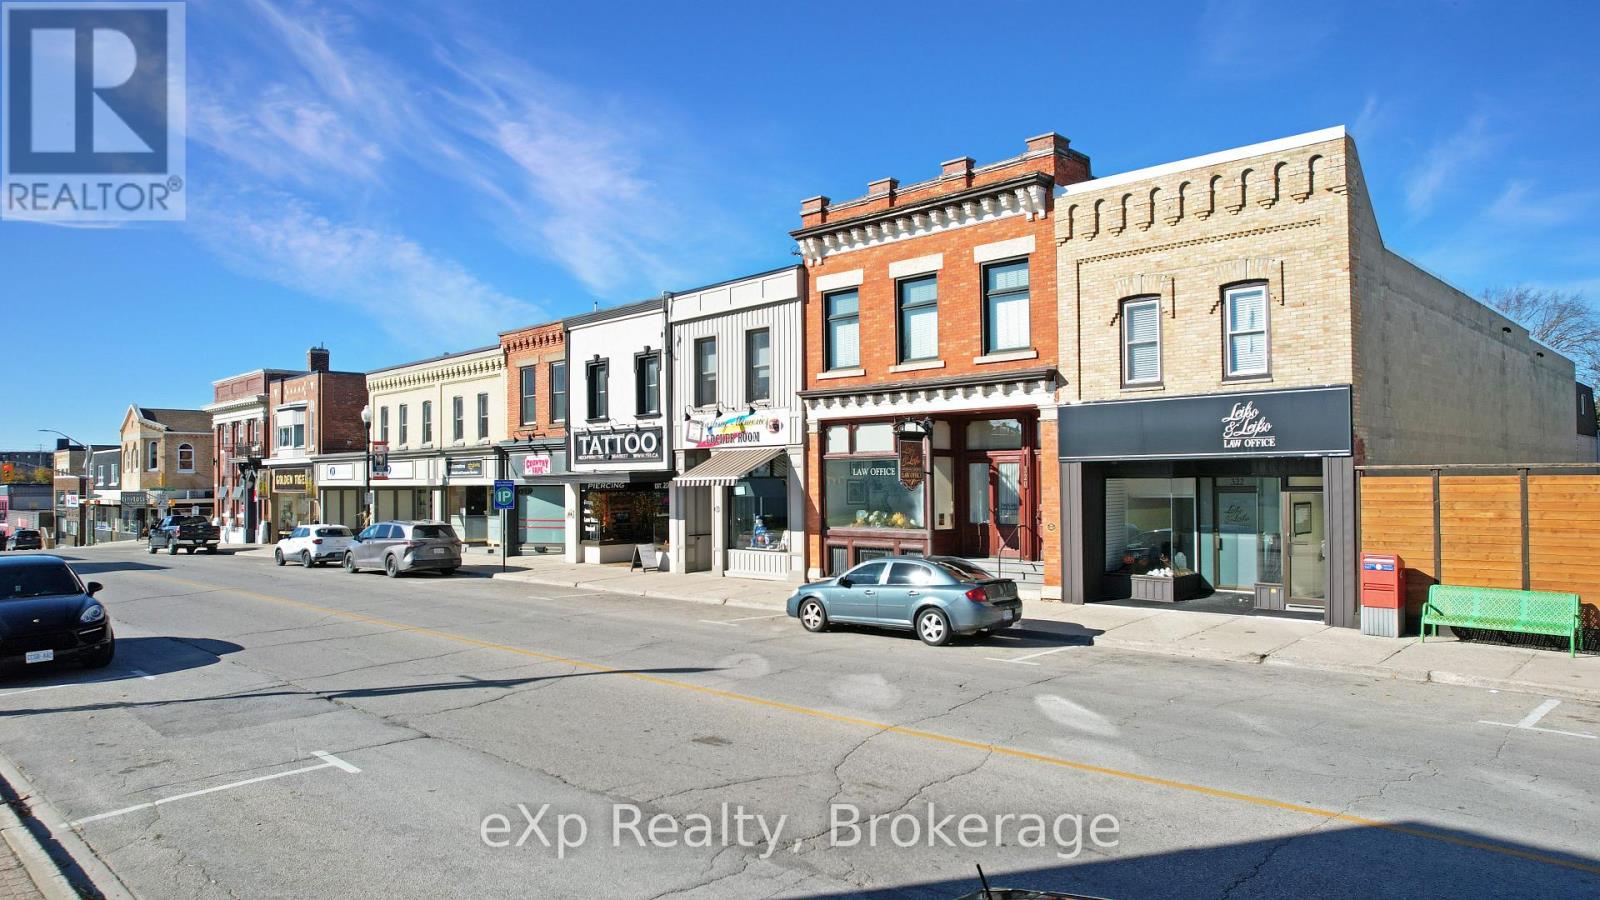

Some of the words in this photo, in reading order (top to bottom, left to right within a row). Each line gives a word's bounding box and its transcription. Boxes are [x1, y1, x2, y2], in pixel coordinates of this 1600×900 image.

[1223, 421, 1239, 438] &
[737, 431, 760, 442] ROOM
[578, 431, 657, 455] TATTOO
[1223, 439, 1241, 448] LAW
[1244, 438, 1276, 447] OFFICE
[852, 467, 869, 476] LAW
[870, 467, 896, 476] OFFICE
[275, 475, 293, 485] GOLDEN
[587, 482, 625, 490] PIERCING
